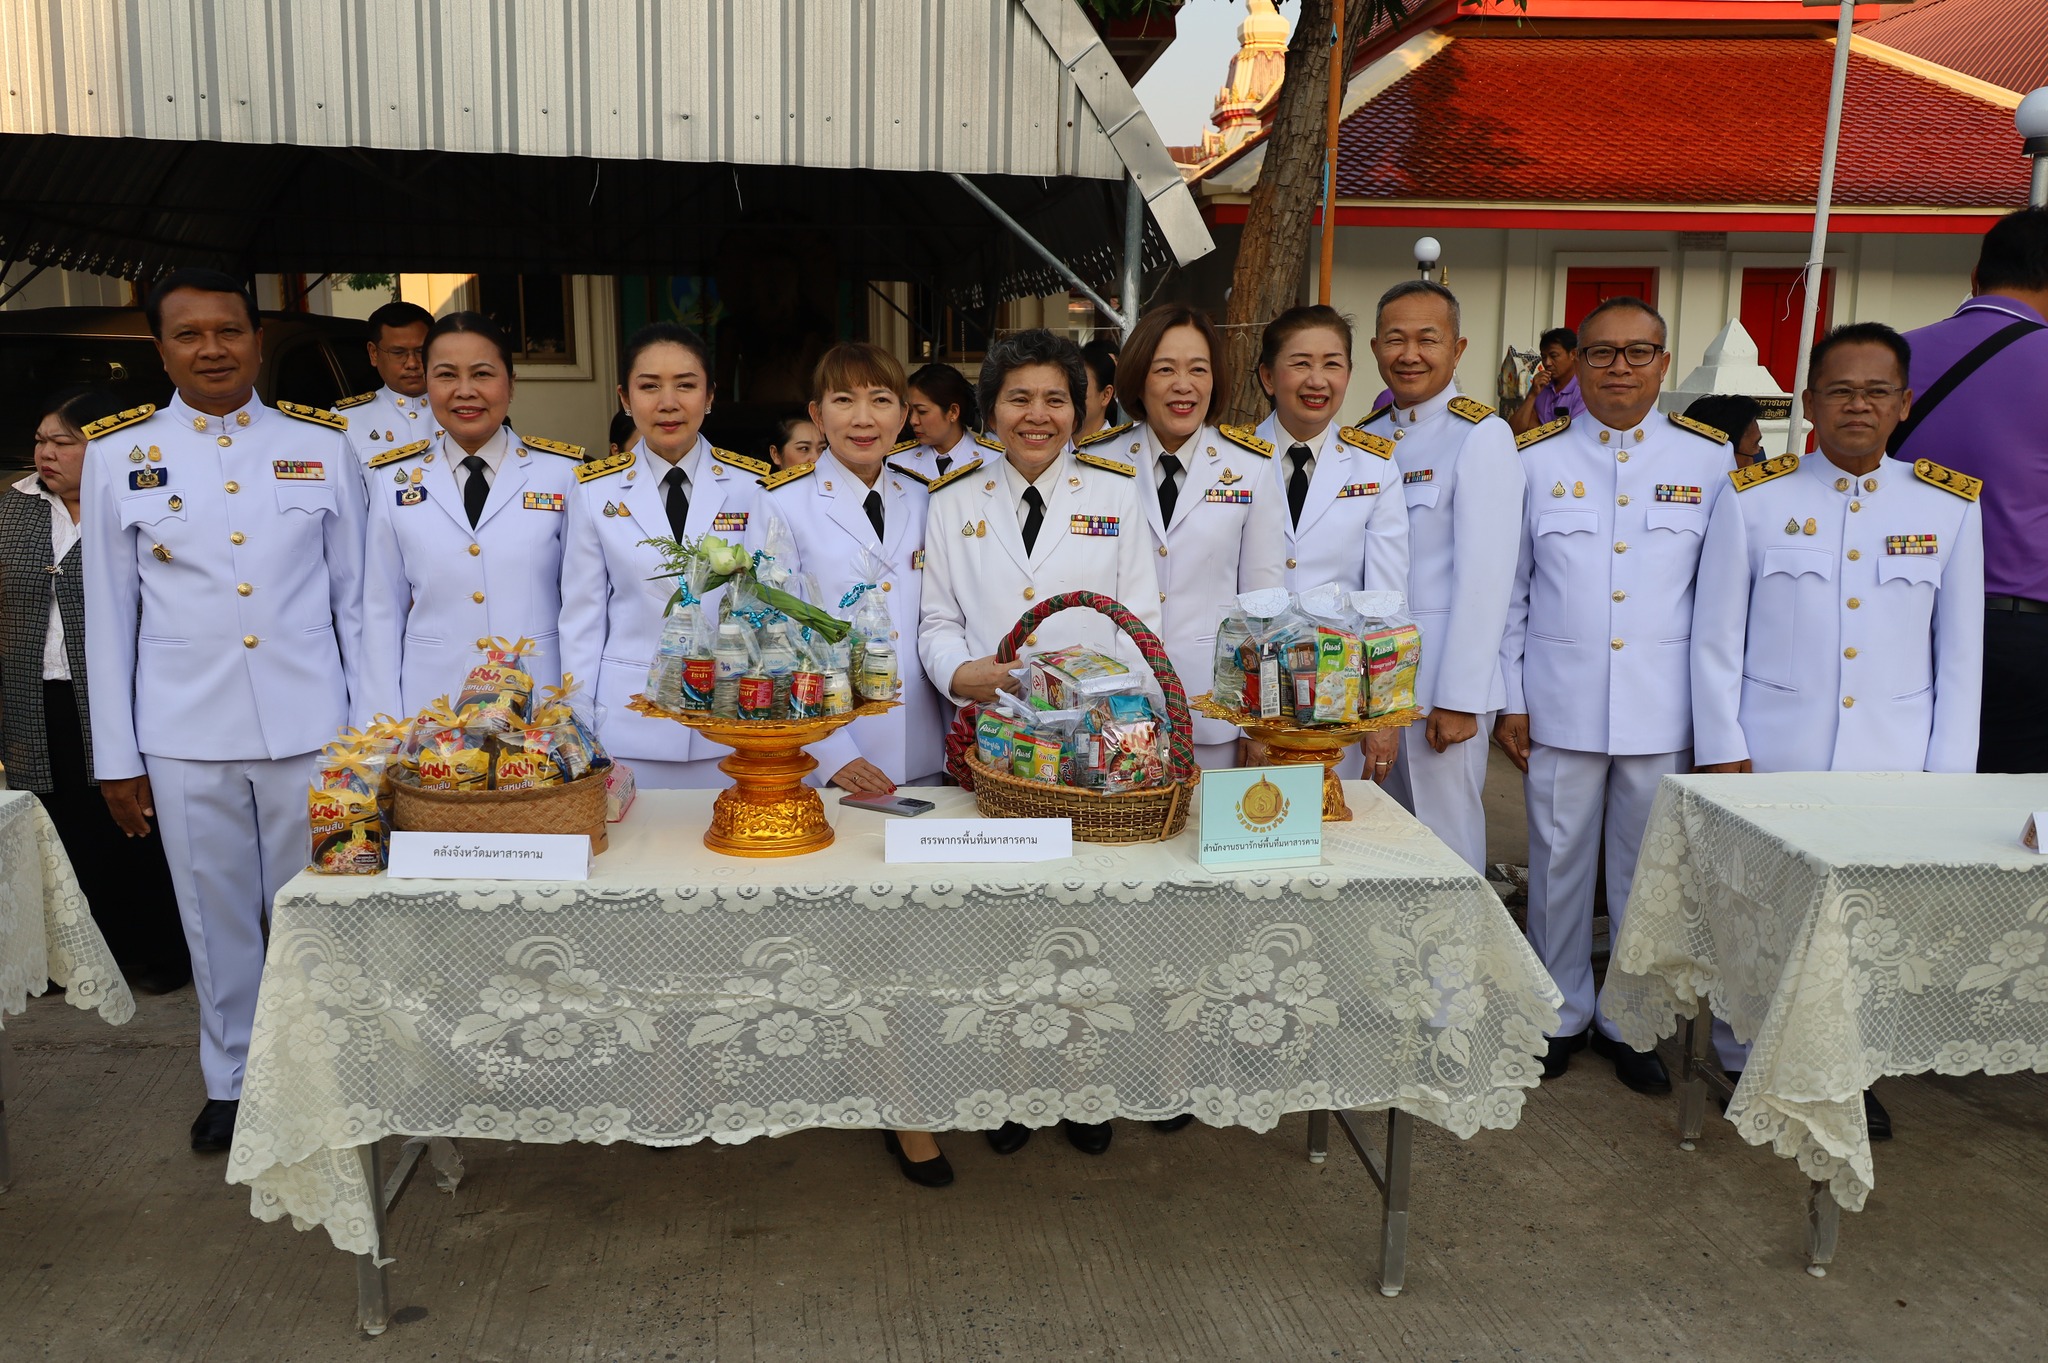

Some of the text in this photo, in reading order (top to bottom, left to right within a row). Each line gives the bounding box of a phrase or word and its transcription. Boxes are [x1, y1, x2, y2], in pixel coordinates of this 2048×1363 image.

[919, 830, 1038, 845] สรรพากรพื้นที่มหาสารคาม
[1203, 836, 1320, 852] สำนักงานธนารักษ์พื้นที่มหาสารคาม
[432, 845, 543, 859] คลังจังหวัดมหาสารคาม
